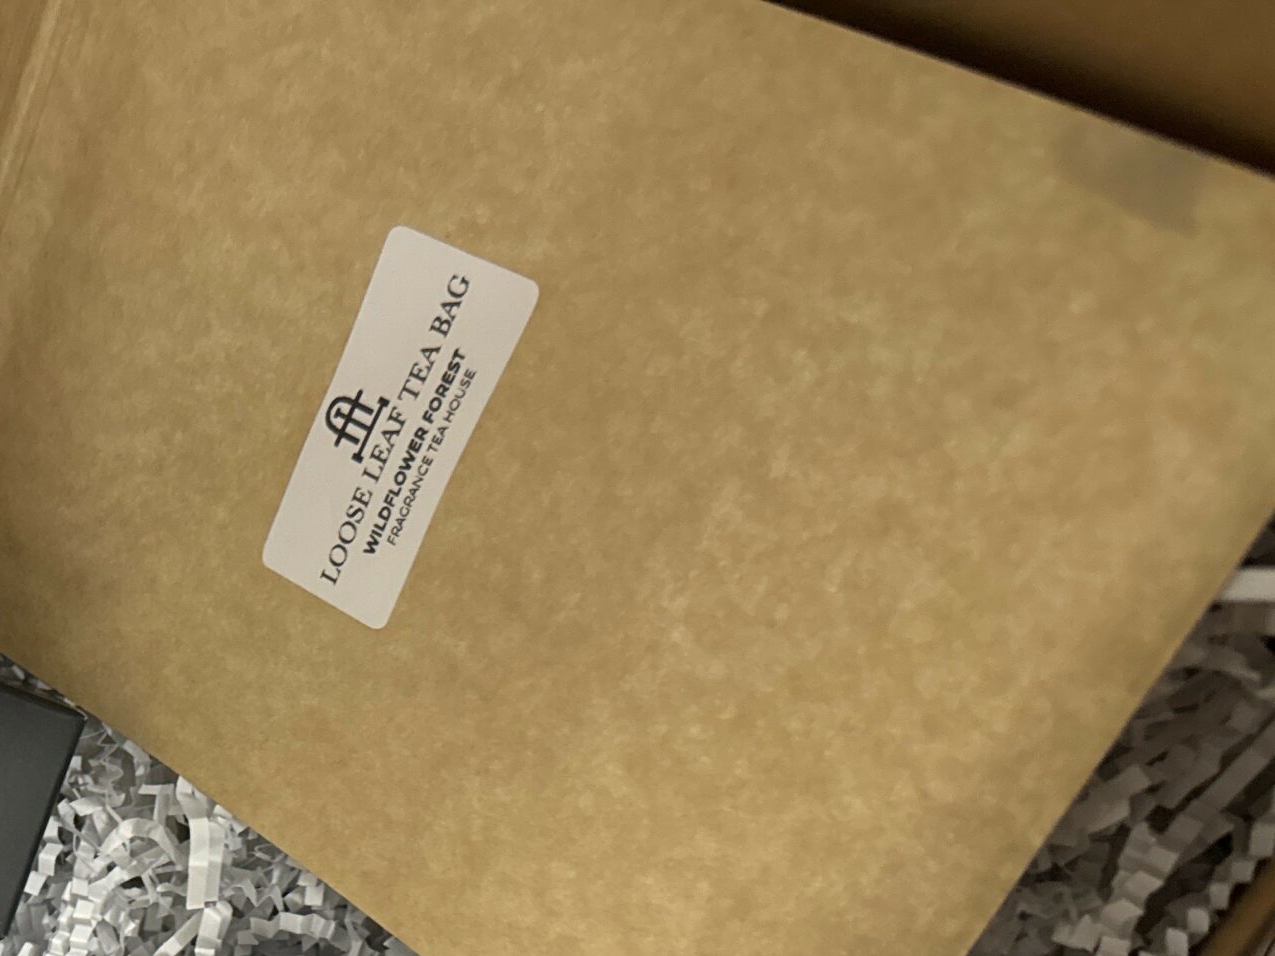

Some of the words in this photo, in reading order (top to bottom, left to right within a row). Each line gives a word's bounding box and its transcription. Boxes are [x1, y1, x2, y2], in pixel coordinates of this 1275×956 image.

[320, 487, 373, 586] LOOSE
[362, 406, 407, 483] LEAF
[398, 344, 442, 401] TEA
[429, 274, 470, 338] BAG
[362, 426, 429, 555] WILDFLOWER
[422, 347, 466, 424] FOREST
[386, 455, 434, 546] FRAGRANCE
[427, 426, 449, 454] TEA
[443, 368, 477, 423] HOUSE
